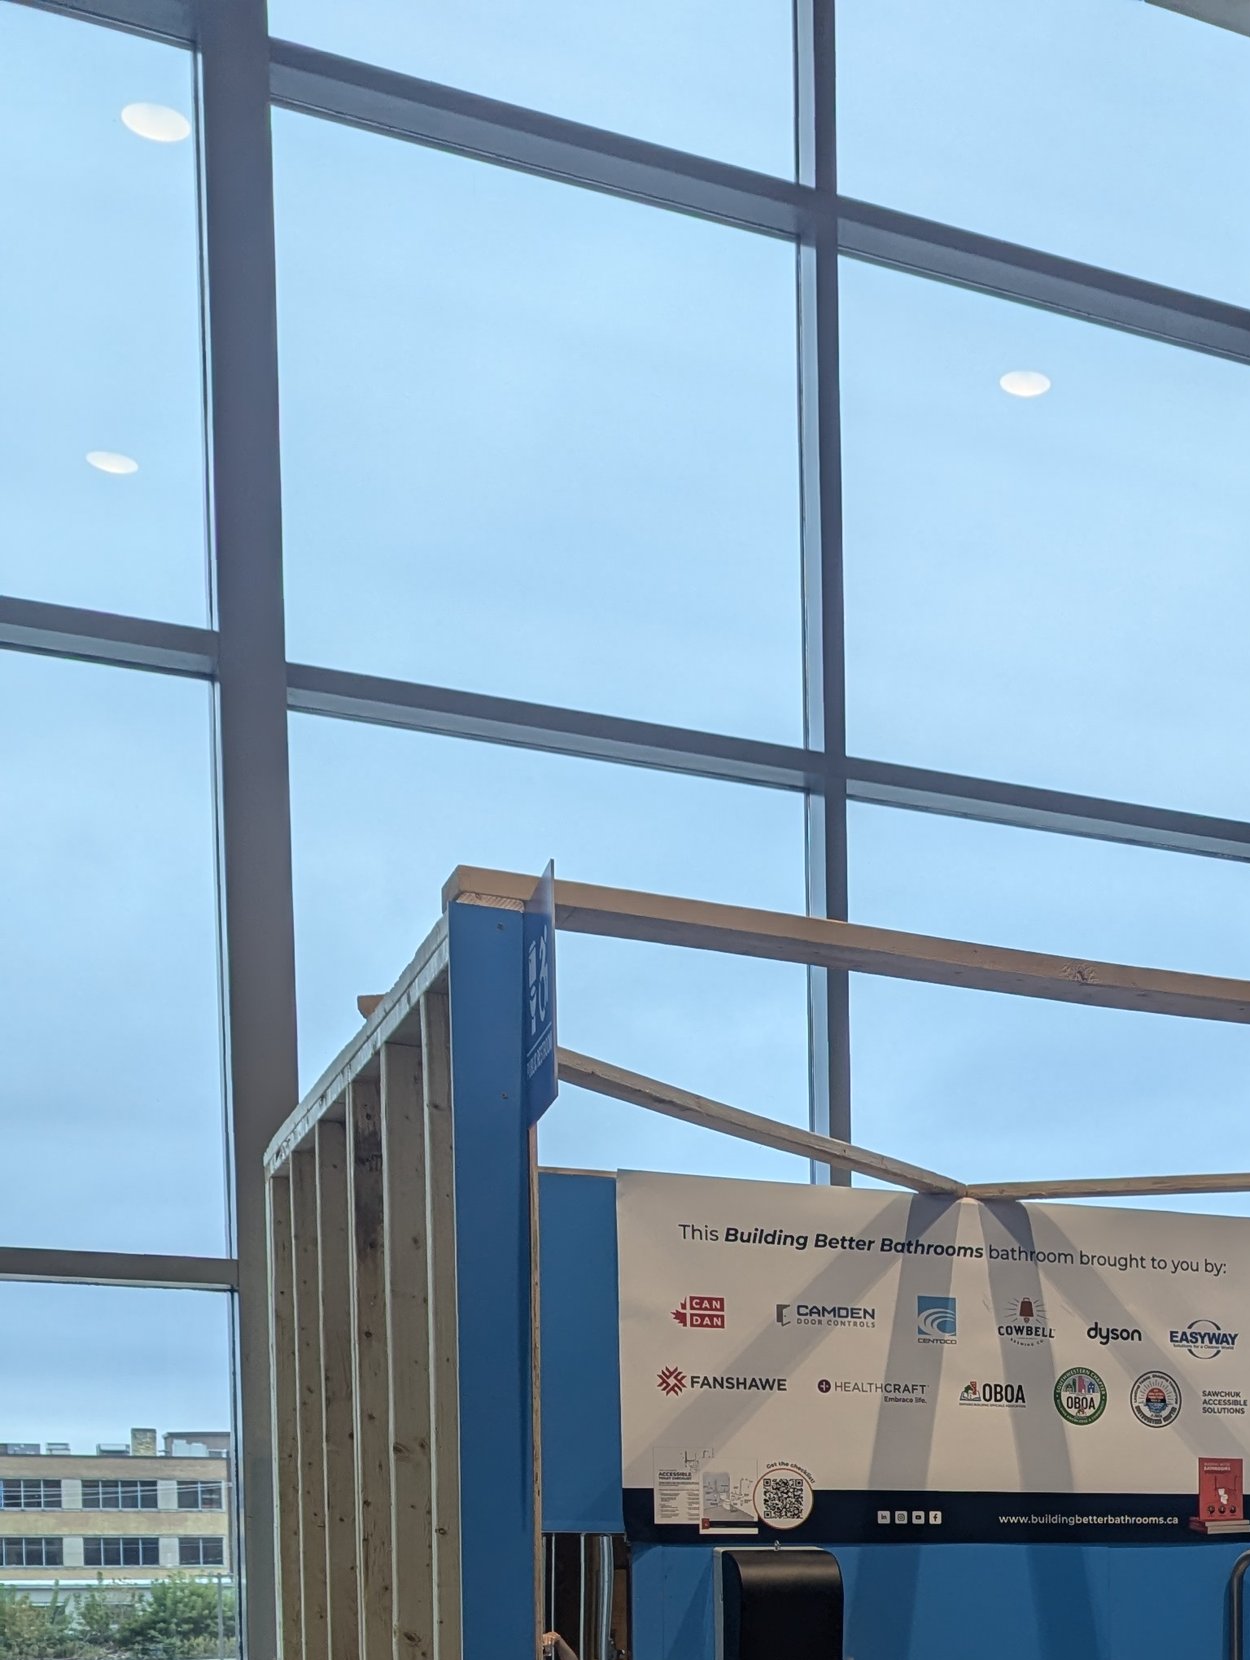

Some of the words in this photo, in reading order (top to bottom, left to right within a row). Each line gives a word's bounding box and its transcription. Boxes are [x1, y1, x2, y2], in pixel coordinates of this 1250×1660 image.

[678, 1224, 719, 1241] This
[724, 1227, 809, 1250] Building
[814, 1233, 875, 1252] Better
[880, 1237, 983, 1259] Bathrooms
[989, 1244, 1074, 1265] bathroom
[1080, 1250, 1146, 1271] brought
[1151, 1254, 1167, 1270] to
[1171, 1257, 1199, 1274] you
[1205, 1258, 1227, 1276] by:
[692, 1299, 721, 1309] CAN
[796, 1304, 876, 1320] CAMDEN
[692, 1316, 722, 1327] DAN
[827, 1319, 876, 1328] CONTROLS
[998, 1325, 1055, 1338] COWBELL
[1086, 1321, 1142, 1345] dyson
[1170, 1330, 1238, 1345] EASYWAY
[917, 1337, 957, 1345] CENTOCO
[691, 1376, 787, 1392] FANSHAWE
[835, 1381, 927, 1394] HEALTHCRAFT
[1055, 1368, 1089, 1393] SOUTHWESTERN
[1090, 1372, 1106, 1395] CHAPTER
[982, 1383, 1026, 1404] OBOA
[1202, 1390, 1241, 1398] SAWCHUK
[1066, 1395, 1096, 1410] OBOA
[998, 1514, 1178, 1526] www.buildingbetterbathrooms.ca
